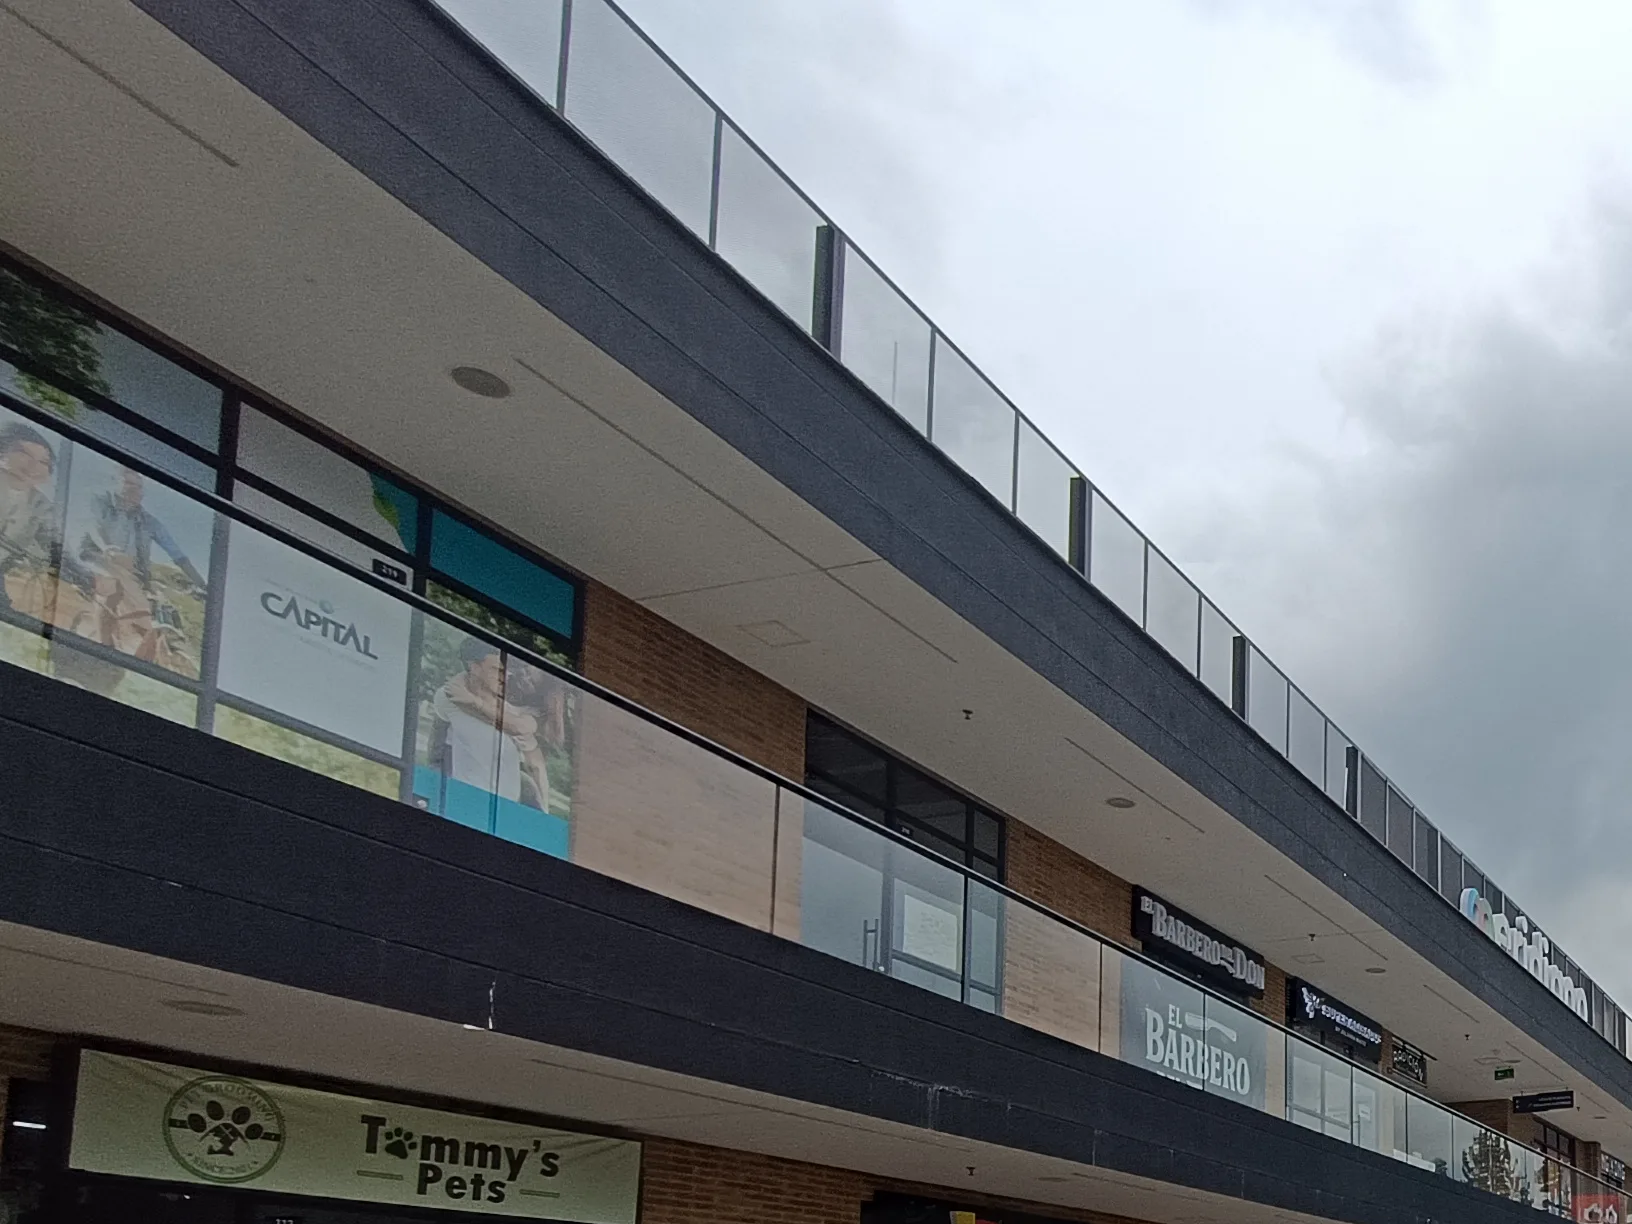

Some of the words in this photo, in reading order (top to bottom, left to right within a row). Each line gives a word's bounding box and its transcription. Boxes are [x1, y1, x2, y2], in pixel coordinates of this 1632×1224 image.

[260, 592, 378, 660] CAPITAL
[1152, 902, 1220, 965] BARBERO
[1460, 888, 1587, 1022] meridiano
[1168, 1004, 1182, 1029] EL
[1145, 1007, 1250, 1095] BARBERO
[416, 1162, 507, 1203] Pets
